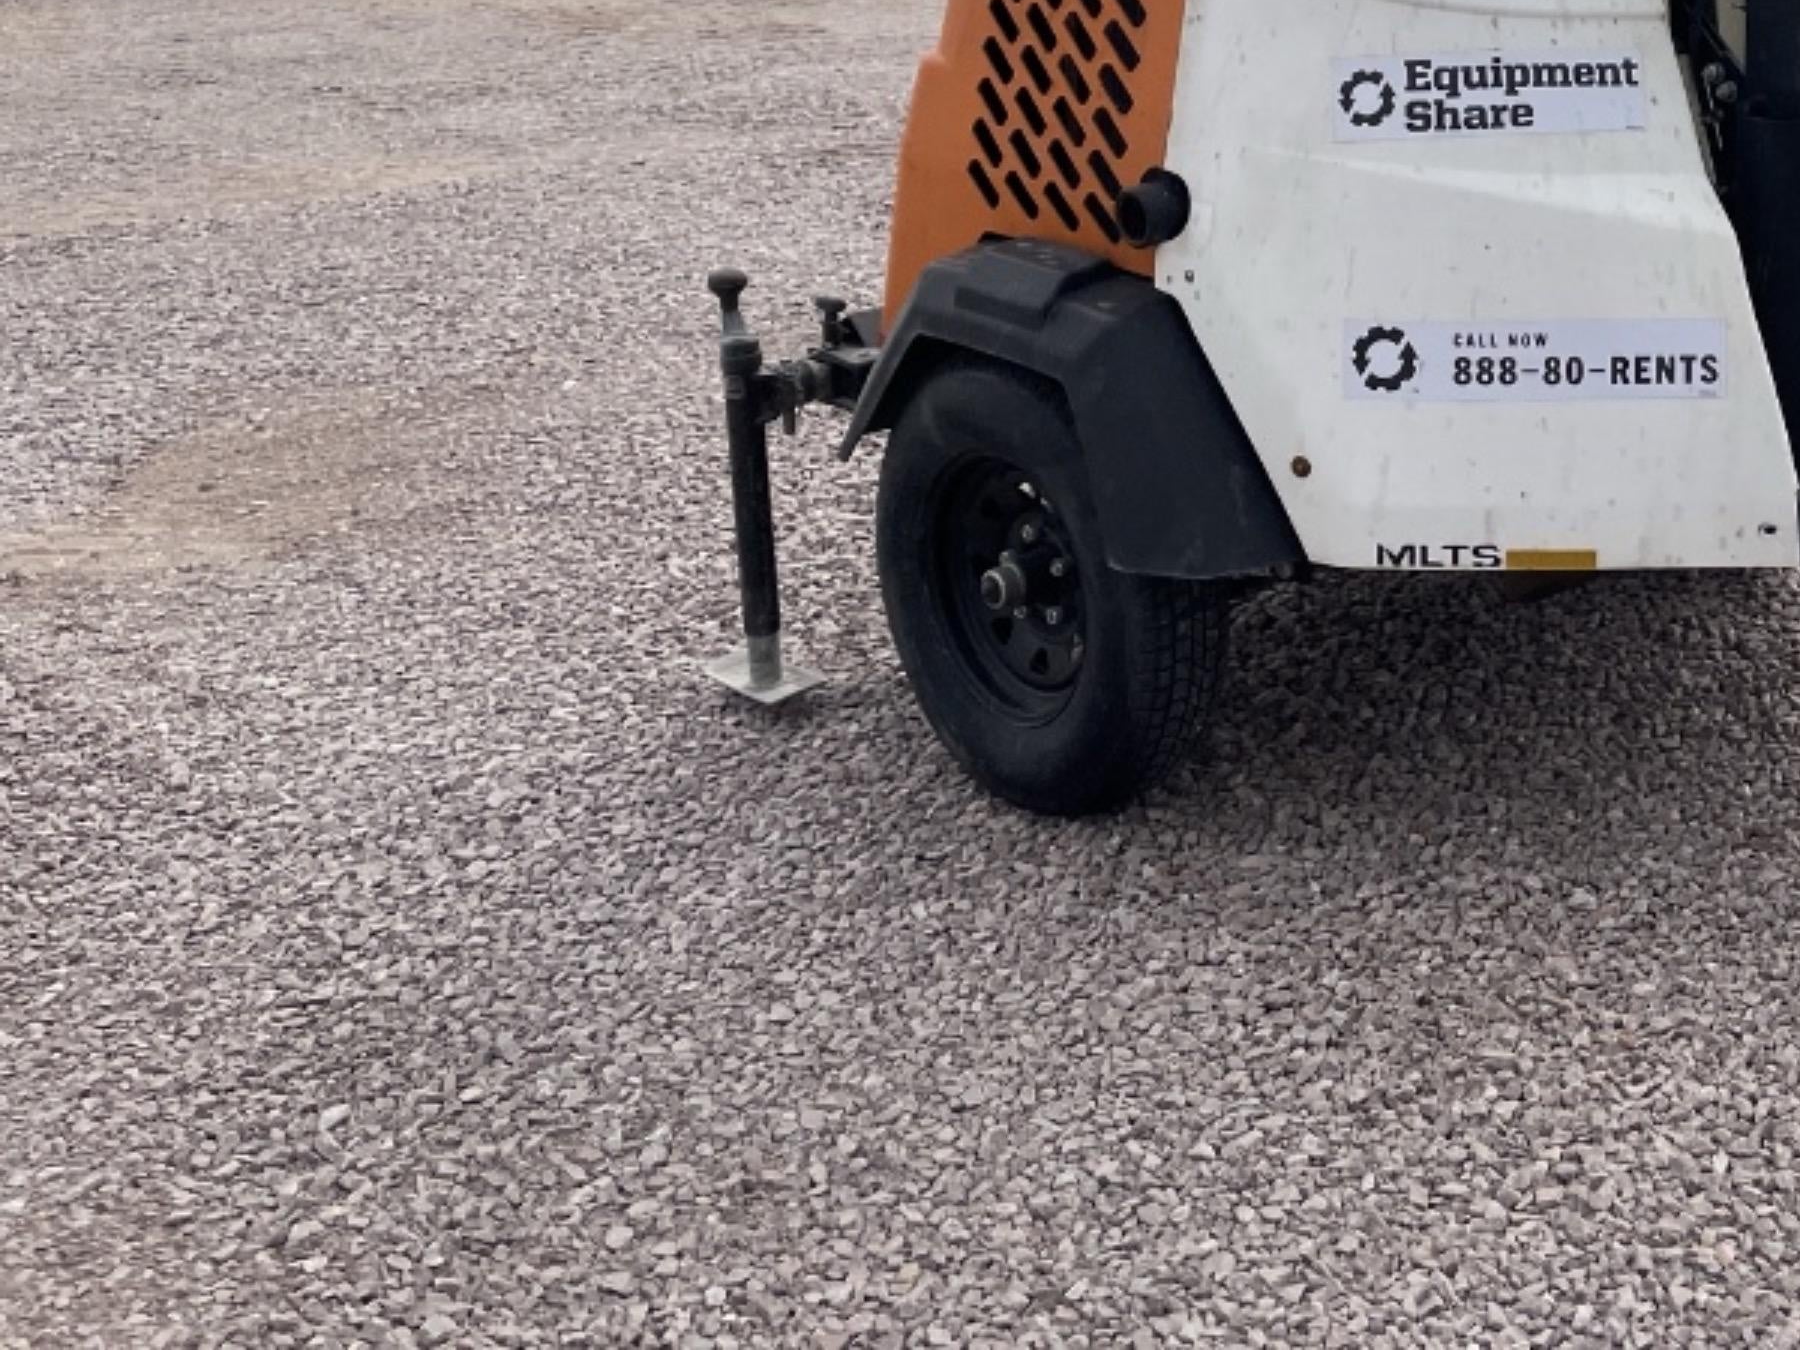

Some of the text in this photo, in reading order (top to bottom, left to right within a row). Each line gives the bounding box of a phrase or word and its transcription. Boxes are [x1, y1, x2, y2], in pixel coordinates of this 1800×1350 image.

[1403, 57, 1639, 98] Equipment
[1404, 99, 1535, 133] Share
[1452, 331, 1549, 348] CALL NOW
[1452, 354, 1720, 386] 888-80-RENTS
[1375, 542, 1502, 568] MLTS
